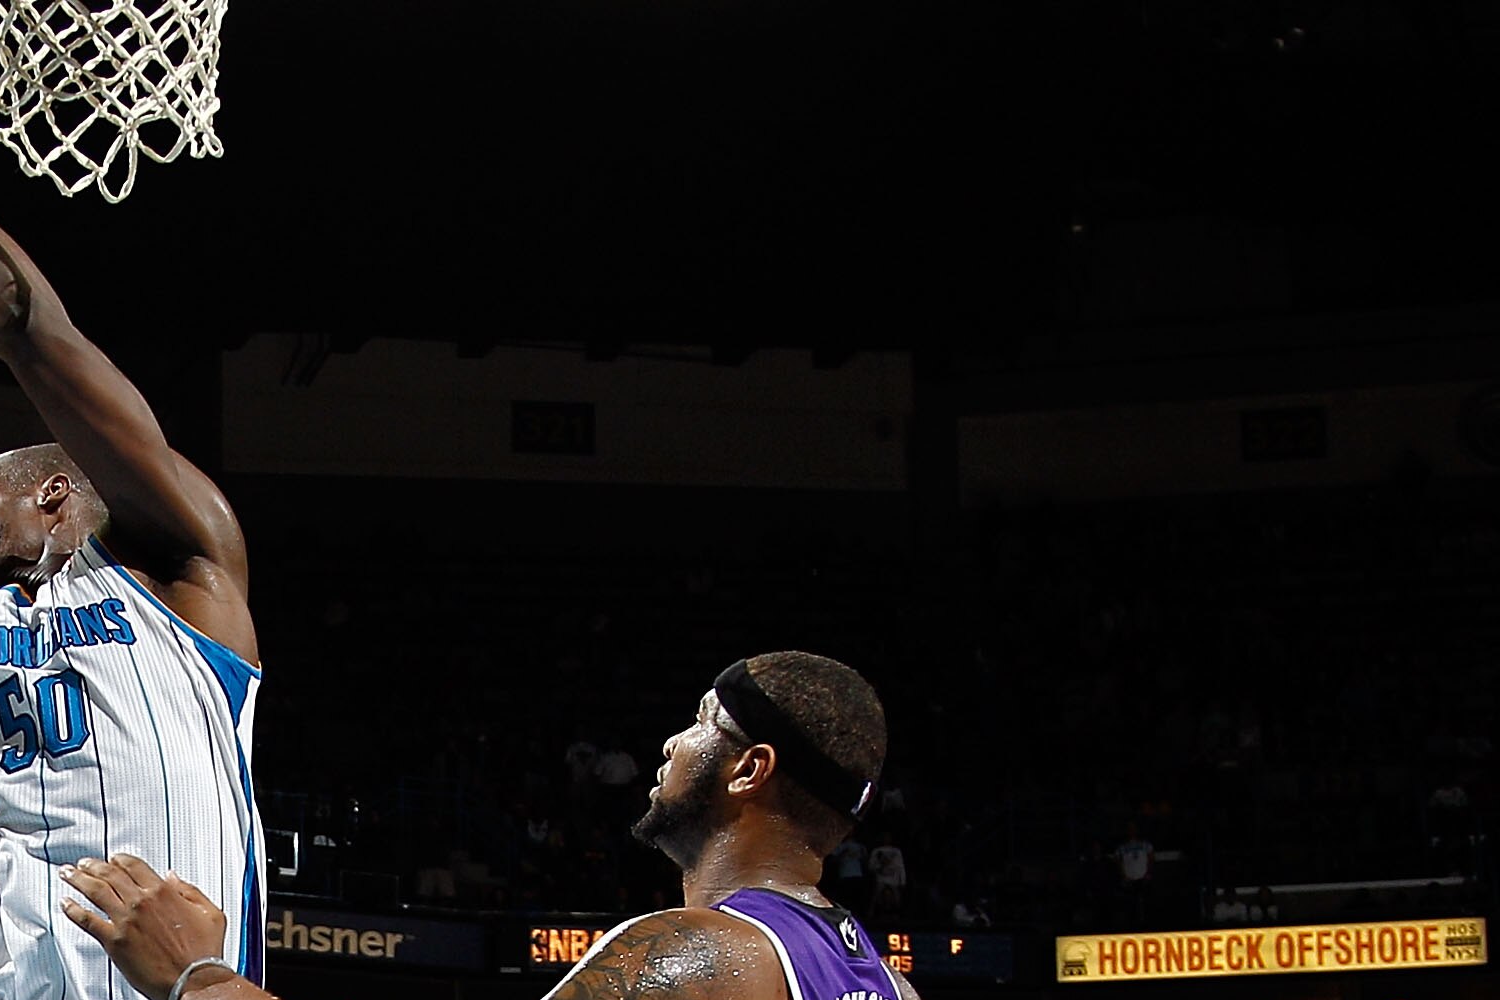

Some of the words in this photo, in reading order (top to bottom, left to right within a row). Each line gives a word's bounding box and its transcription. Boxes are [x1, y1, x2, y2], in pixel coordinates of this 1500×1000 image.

[267, 910, 403, 958] chsner
[549, 929, 604, 962] NB
[888, 934, 911, 951] 91
[951, 939, 963, 954] F
[1098, 932, 1265, 975] HORNBECK
[1276, 925, 1440, 968] OFFSHORE
